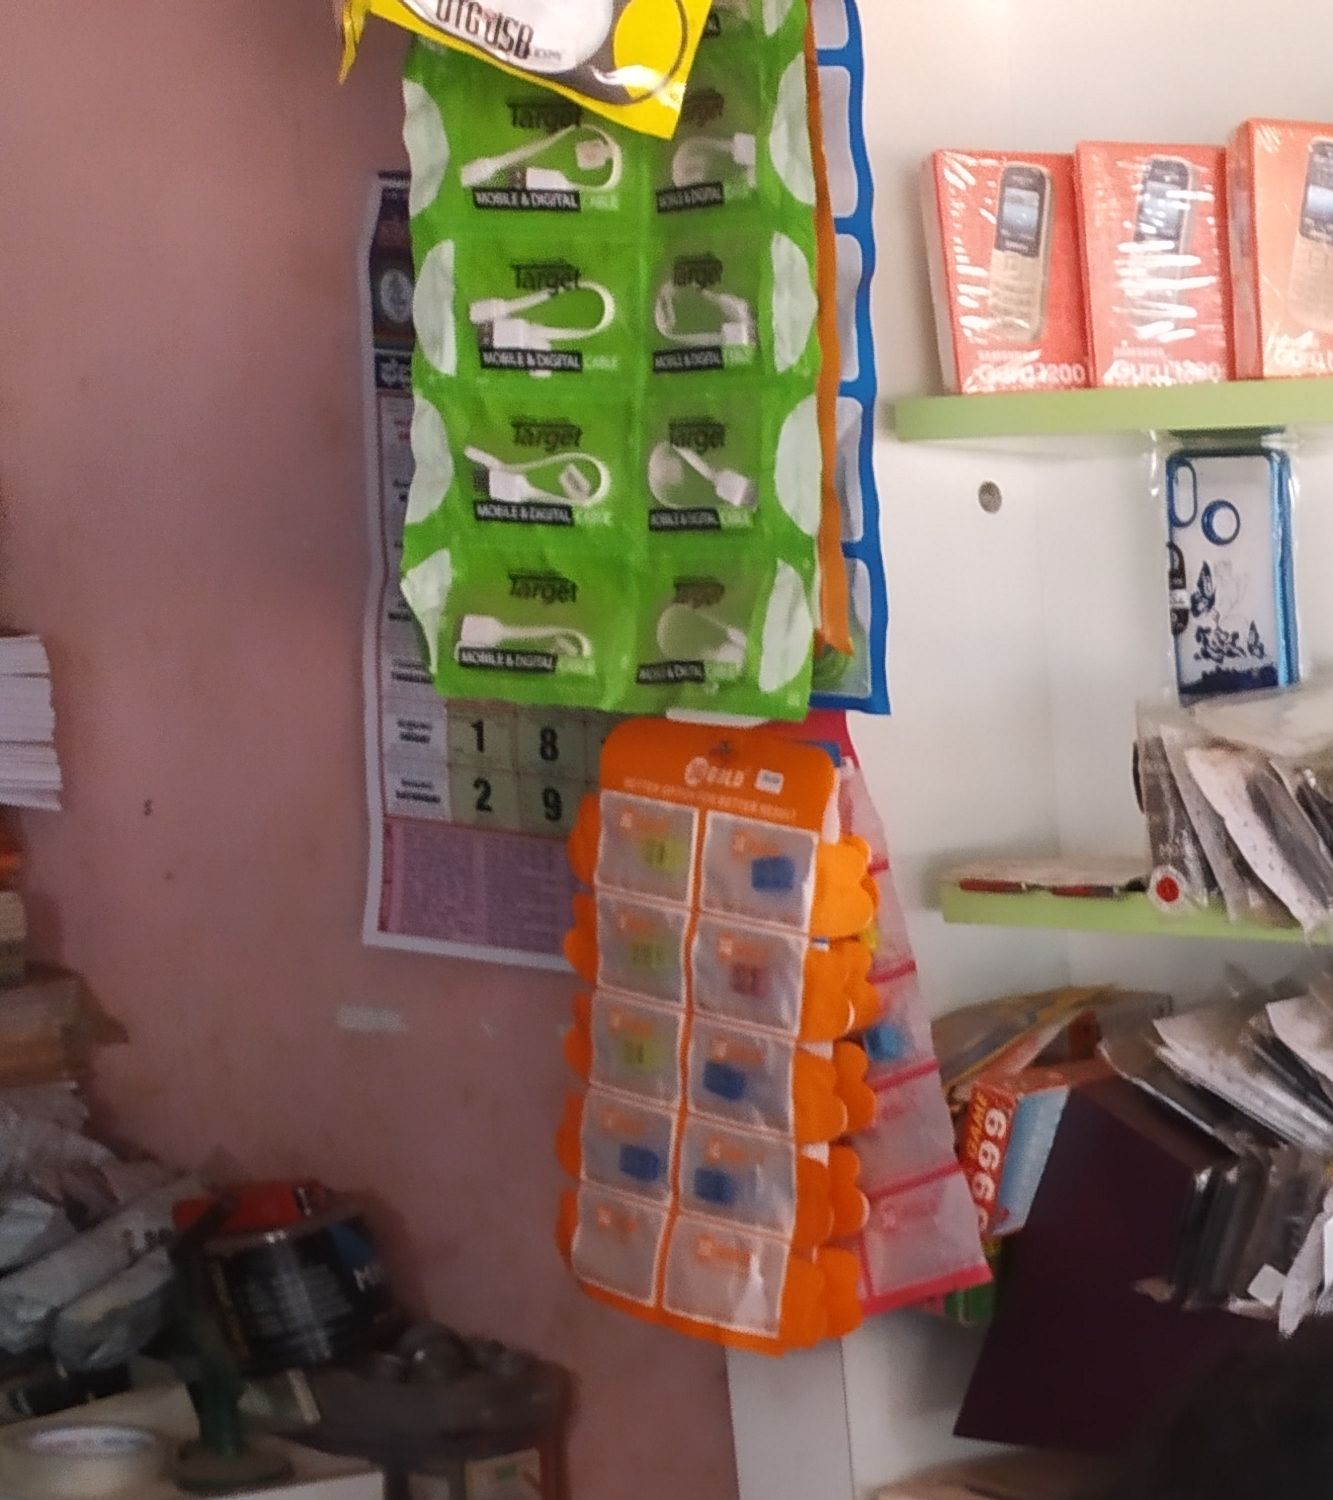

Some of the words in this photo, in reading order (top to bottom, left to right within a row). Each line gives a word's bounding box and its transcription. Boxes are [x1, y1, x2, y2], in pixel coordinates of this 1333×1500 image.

[476, 190, 519, 208] MOBILE
[521, 192, 530, 208] &
[532, 192, 578, 209] DIGITAL
[484, 352, 524, 367] MOBILE
[536, 353, 580, 368] DIGITAL
[476, 502, 520, 518] MOBILE
[529, 504, 571, 520] DIGITAL
[470, 719, 485, 753] 1
[540, 727, 559, 761] 8
[473, 778, 492, 813] 2
[542, 787, 562, 821] 9
